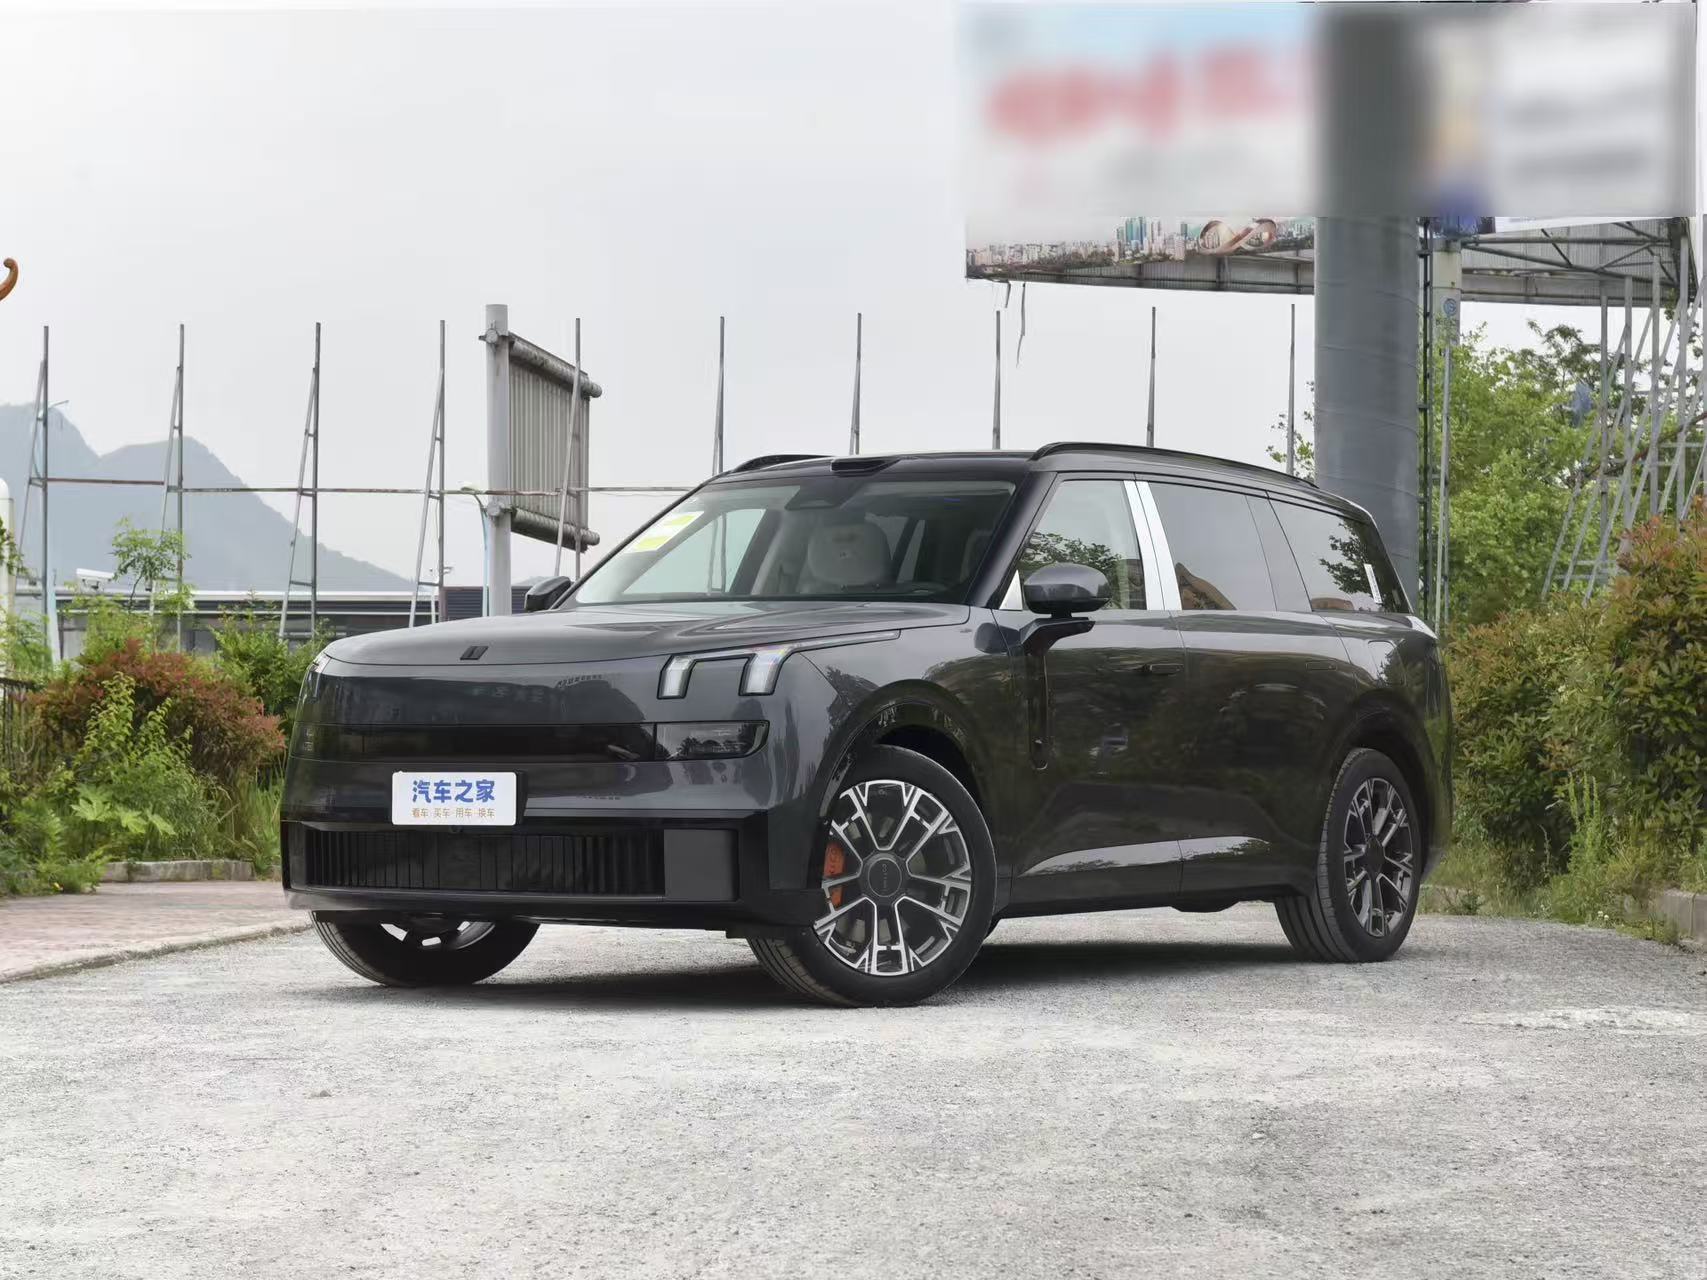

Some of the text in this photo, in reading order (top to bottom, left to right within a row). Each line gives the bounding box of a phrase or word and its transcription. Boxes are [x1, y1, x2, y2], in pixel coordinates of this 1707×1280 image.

[412, 779, 495, 803] 汽车之家
[412, 807, 429, 818] 看车
[434, 807, 450, 818] 买车
[455, 807, 472, 818] 用车
